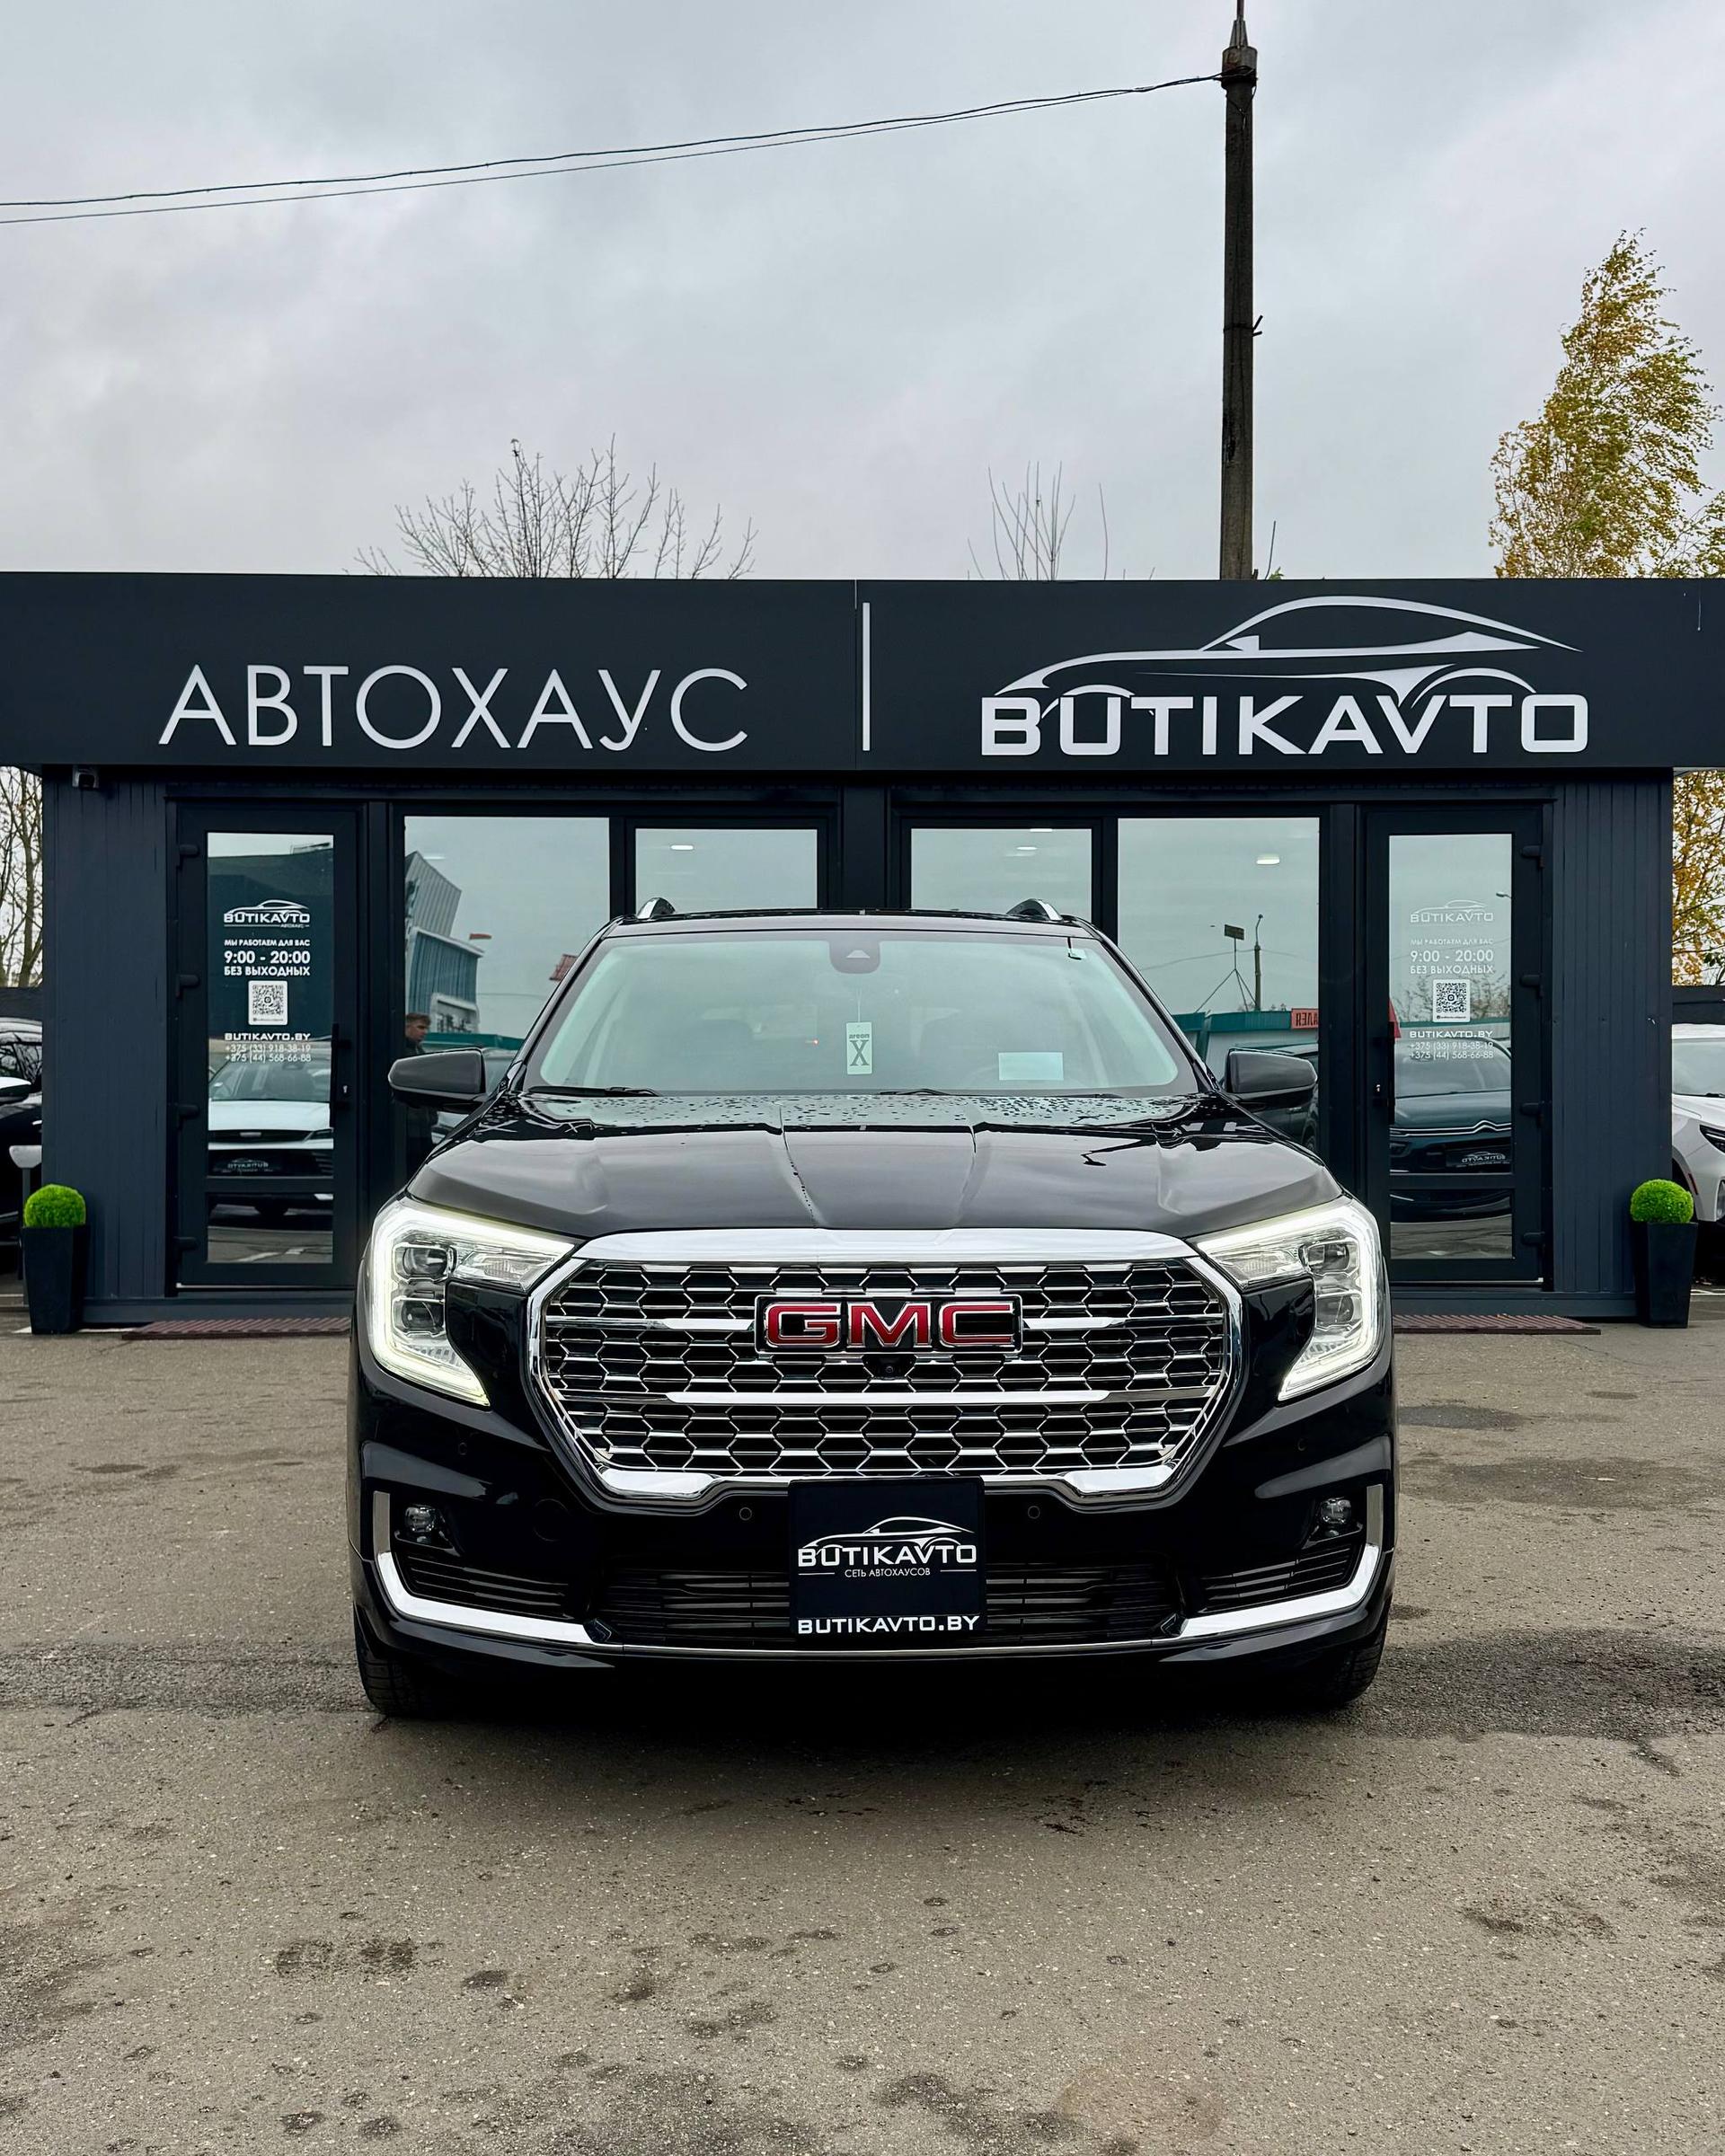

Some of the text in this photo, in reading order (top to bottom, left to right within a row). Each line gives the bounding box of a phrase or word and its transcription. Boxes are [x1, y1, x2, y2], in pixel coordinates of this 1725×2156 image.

[158, 663, 748, 752] АВТОХАУС
[981, 694, 1588, 755] BUTIKAVTO
[223, 913, 310, 923] BUTIKAVTO
[1410, 912, 1494, 923] BUTIKAVTO
[224, 939, 238, 947] МЫ
[239, 939, 277, 947] РАБОТАЕМ
[278, 939, 294, 947] ДЛЯ
[224, 950, 255, 964] 9:00
[270, 950, 310, 964] 20:00
[1410, 950, 1439, 962] 9:00
[1455, 950, 1494, 962] 20:00
[224, 966, 310, 976] БЕЗ ВЫХОДНЫХ
[1410, 964, 1494, 975] БЕЗ ВЫХОДНЫХ
[224, 1032, 311, 1041] BUTIKAVTO.BY
[1410, 1030, 1493, 1038] BUTIKAVTO.BY
[849, 1039, 870, 1066] X
[765, 1302, 1015, 1348] GMC
[798, 1545, 977, 1567] BUTIKAVTO
[845, 1568, 931, 1577] СЕТЬ АВТОХАУСОВ
[798, 1615, 980, 1634] BUTIKAVTO.BY
